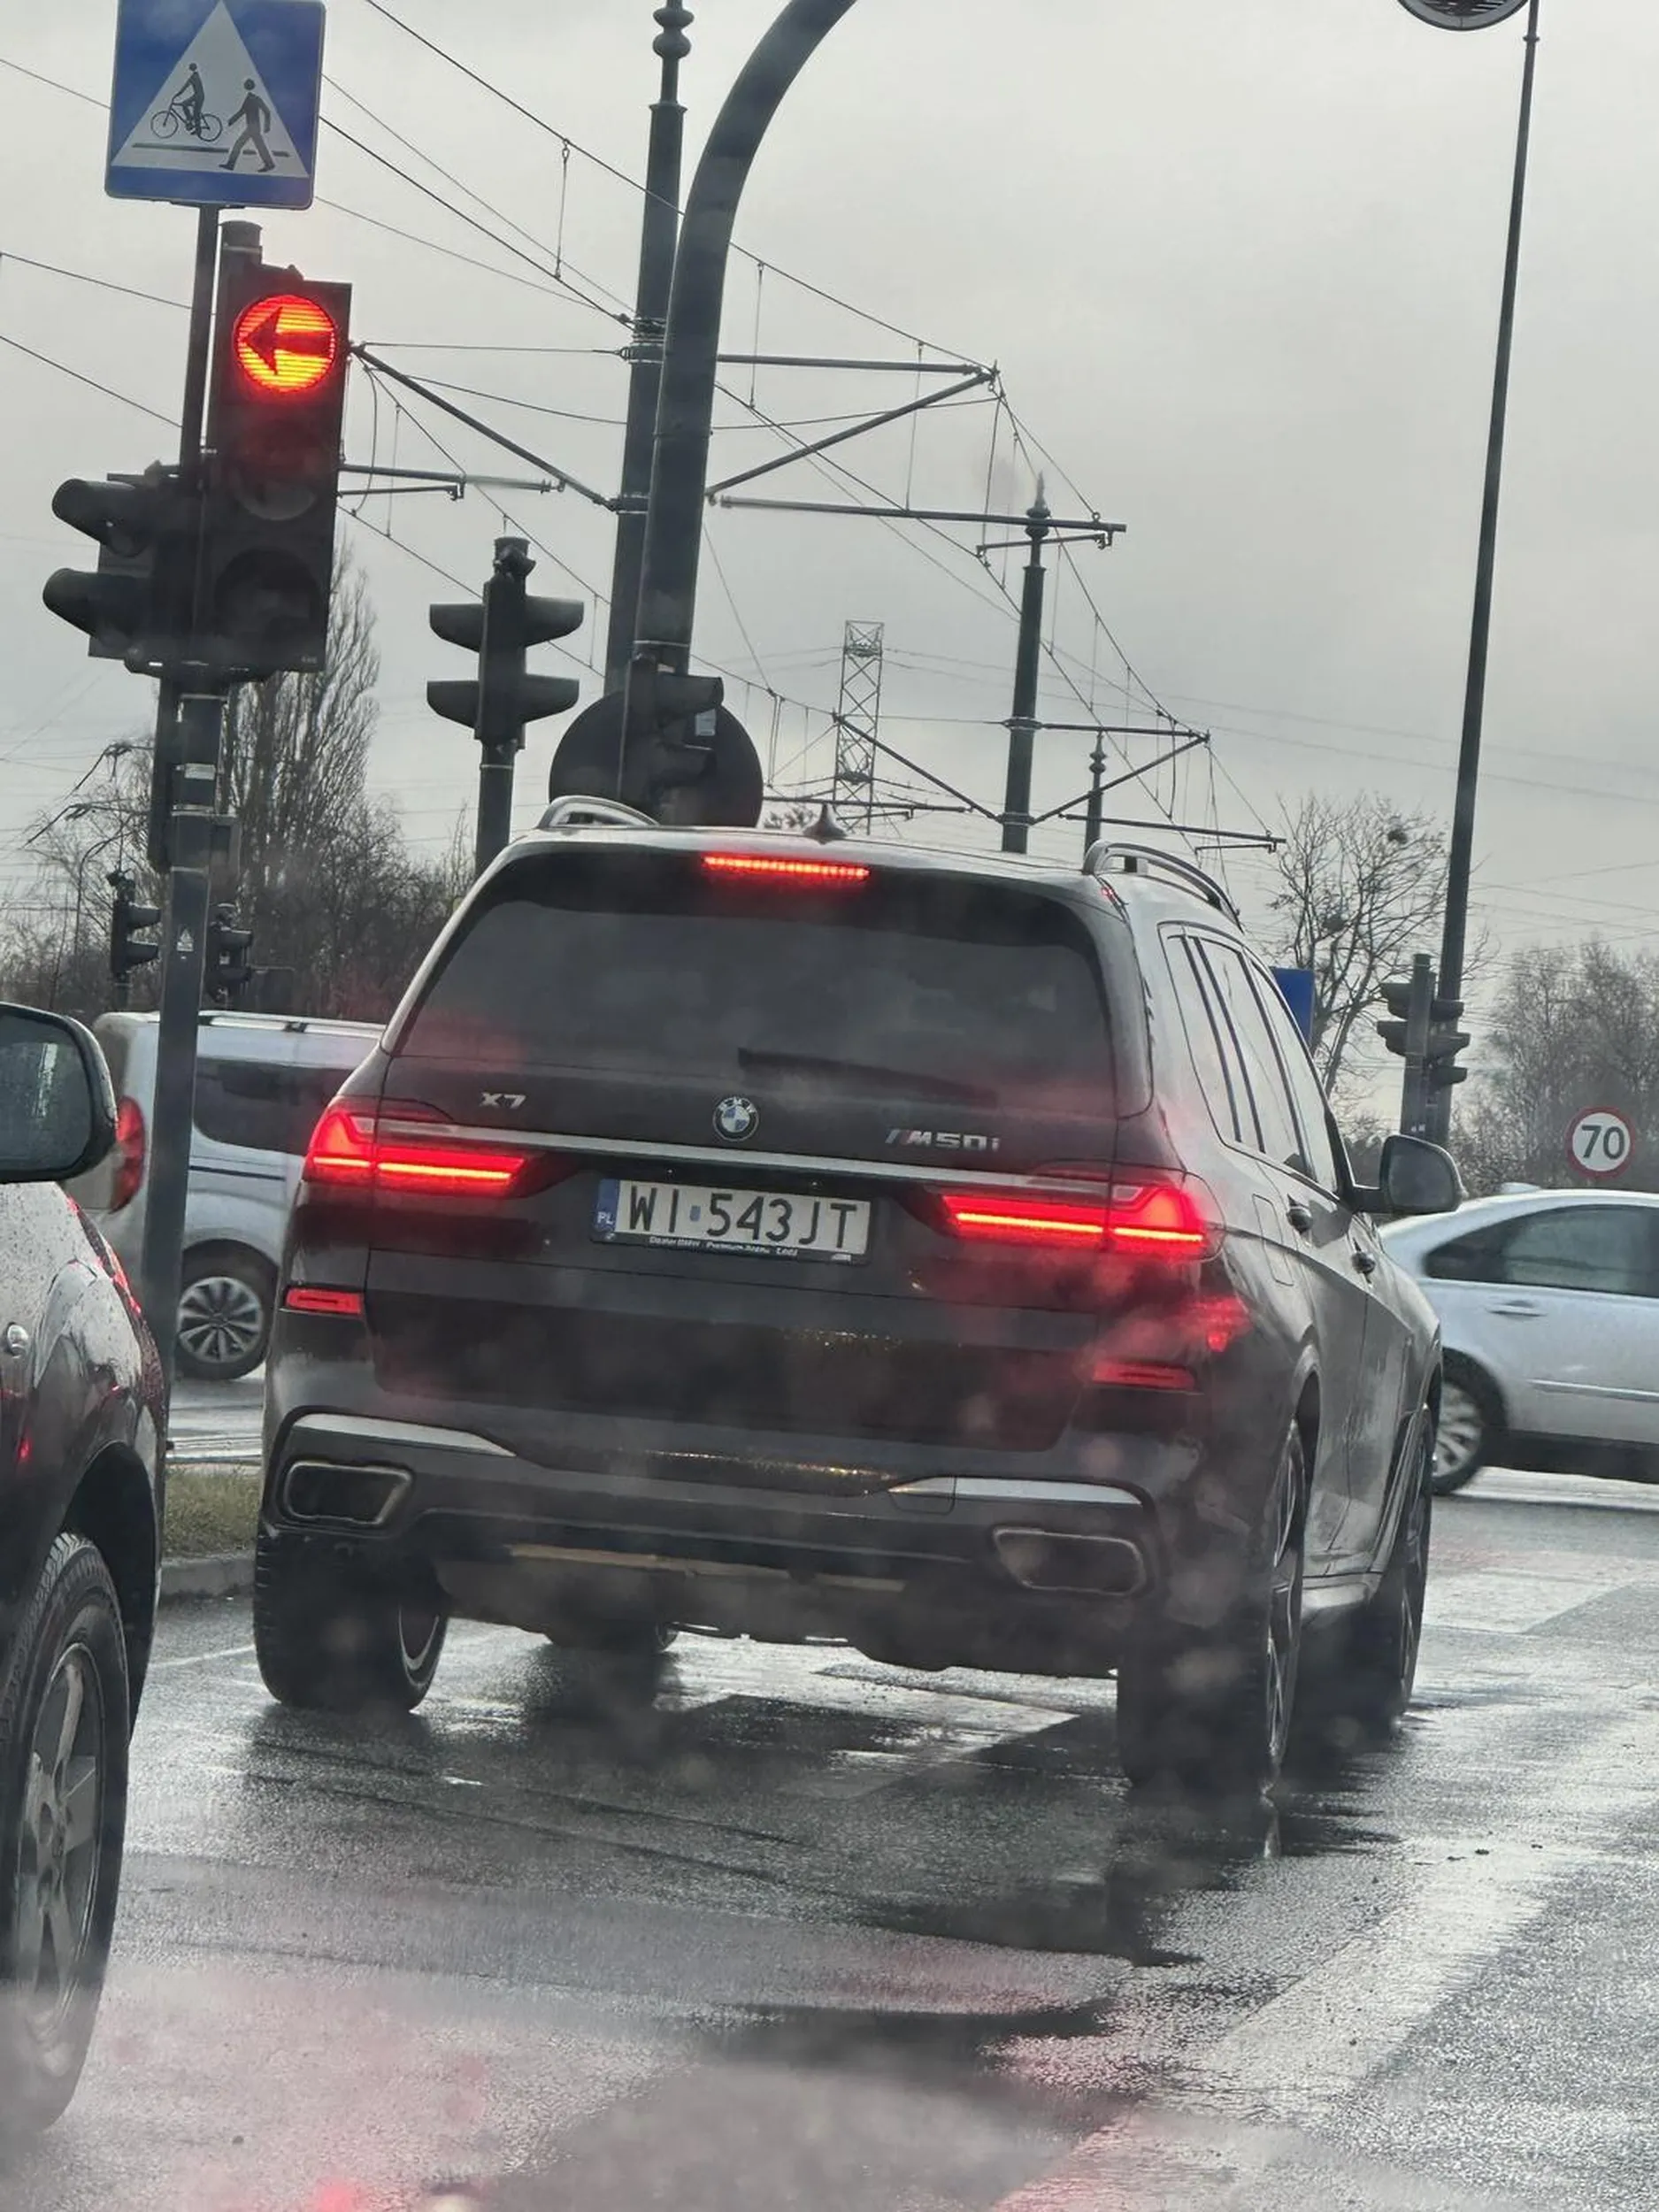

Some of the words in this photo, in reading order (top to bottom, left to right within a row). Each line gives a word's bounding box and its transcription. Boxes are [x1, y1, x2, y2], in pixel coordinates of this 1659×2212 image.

[480, 1093, 526, 1109] X7
[1581, 1125, 1624, 1160] 70
[597, 1211, 614, 1225] PL
[629, 1186, 679, 1233] WI
[707, 1193, 856, 1248] 543JT
